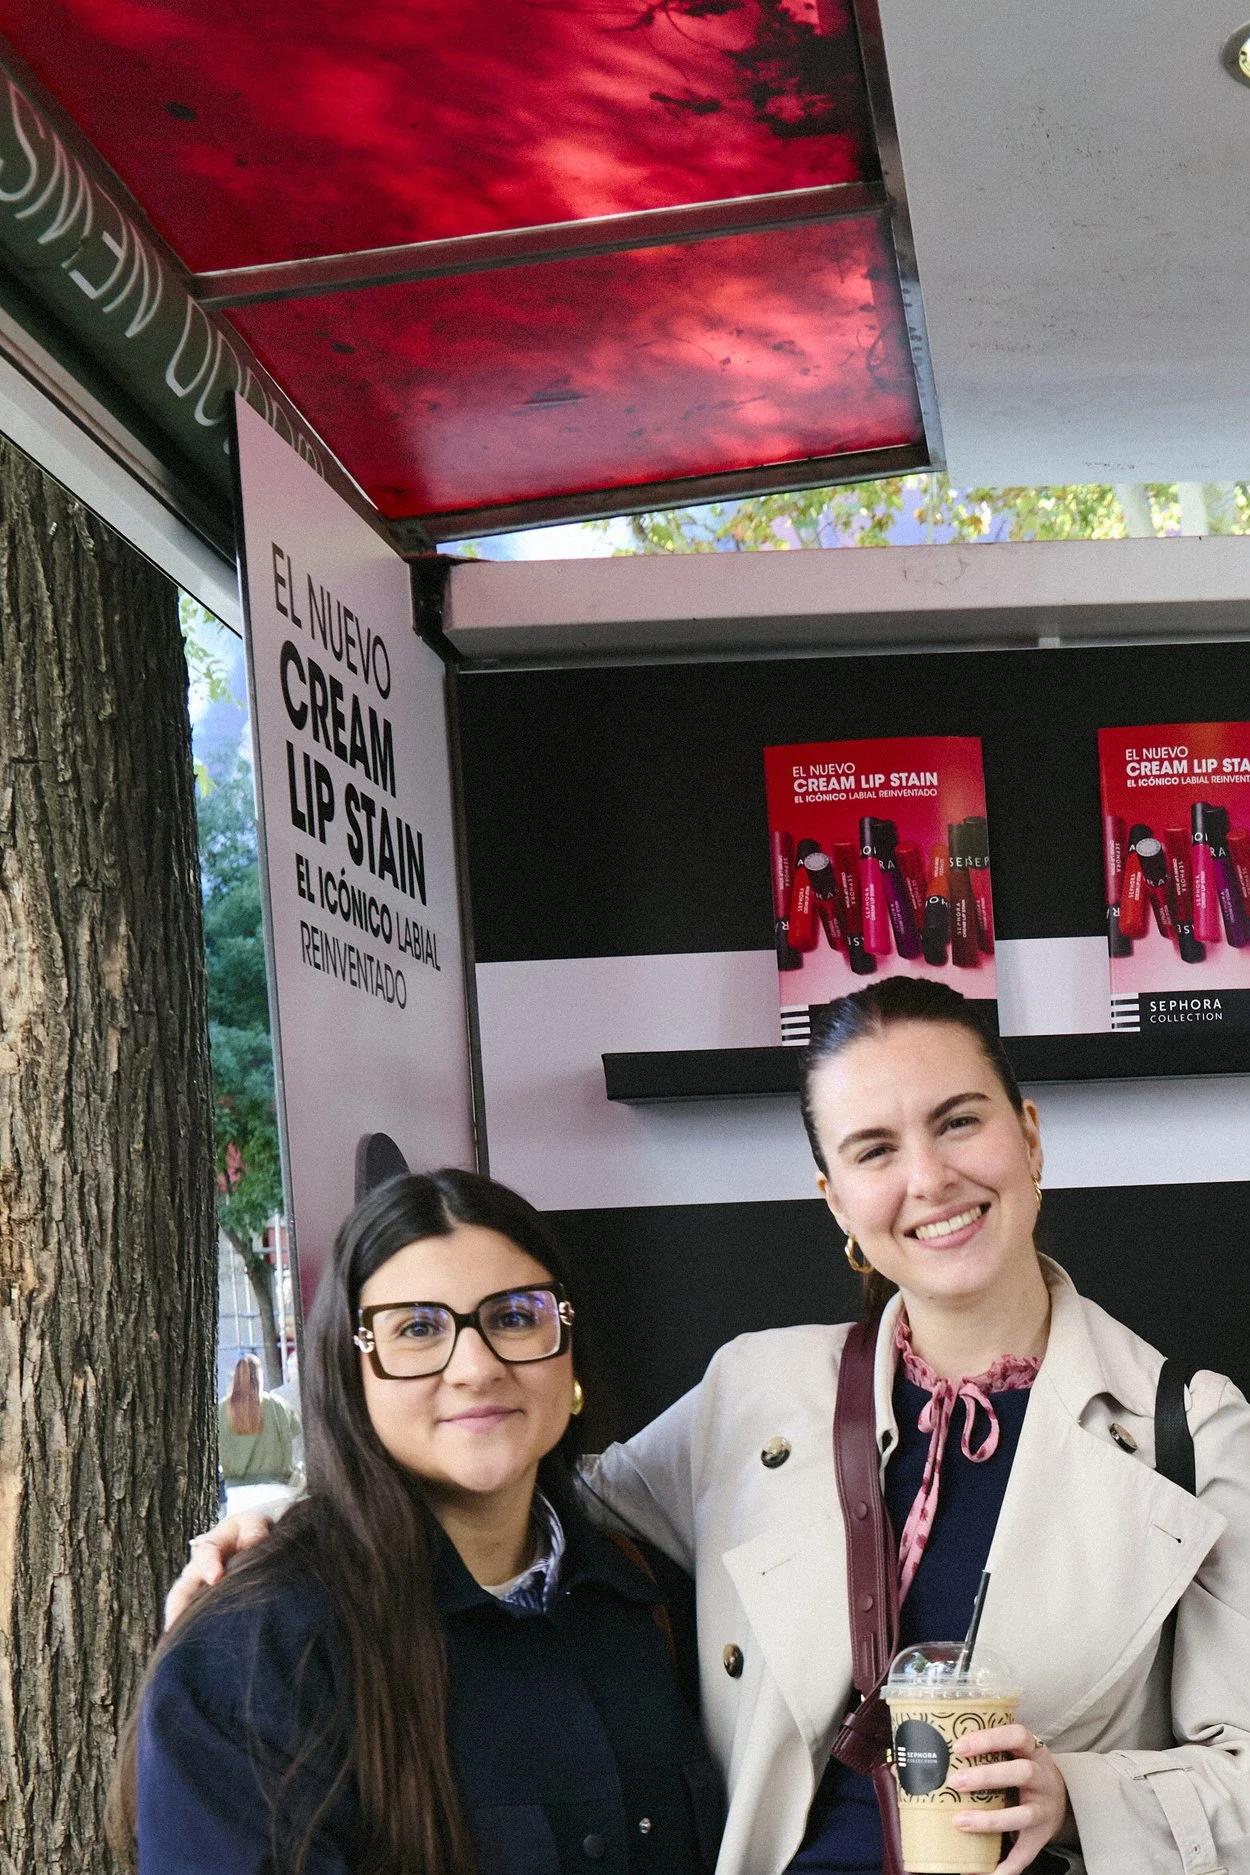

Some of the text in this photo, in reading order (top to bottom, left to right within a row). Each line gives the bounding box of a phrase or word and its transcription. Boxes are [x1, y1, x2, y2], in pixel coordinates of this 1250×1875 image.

[270, 541, 393, 701] EL NUEVO
[279, 639, 397, 799] CREAM
[1125, 746, 1188, 761] EL NUEVO
[793, 762, 856, 778] EL NUEVO
[1126, 760, 1189, 776] CREAM
[1193, 758, 1218, 773] LIP
[793, 771, 938, 793] CREAM LIP STAIN
[1127, 779, 1137, 787] EL
[1138, 776, 1179, 787] ICÓNICO
[1180, 776, 1209, 785] LABIAL
[794, 788, 937, 804] EL ICÓNICO LABIAL REINVENTADO
[285, 740, 428, 907] LIP STAIN
[295, 852, 442, 973] EL ICÓNICO LABIAL
[300, 919, 408, 1010] REINVENTADO
[1150, 998, 1222, 1013] SEPHORA
[1150, 1013, 1223, 1024] COLLECTION
